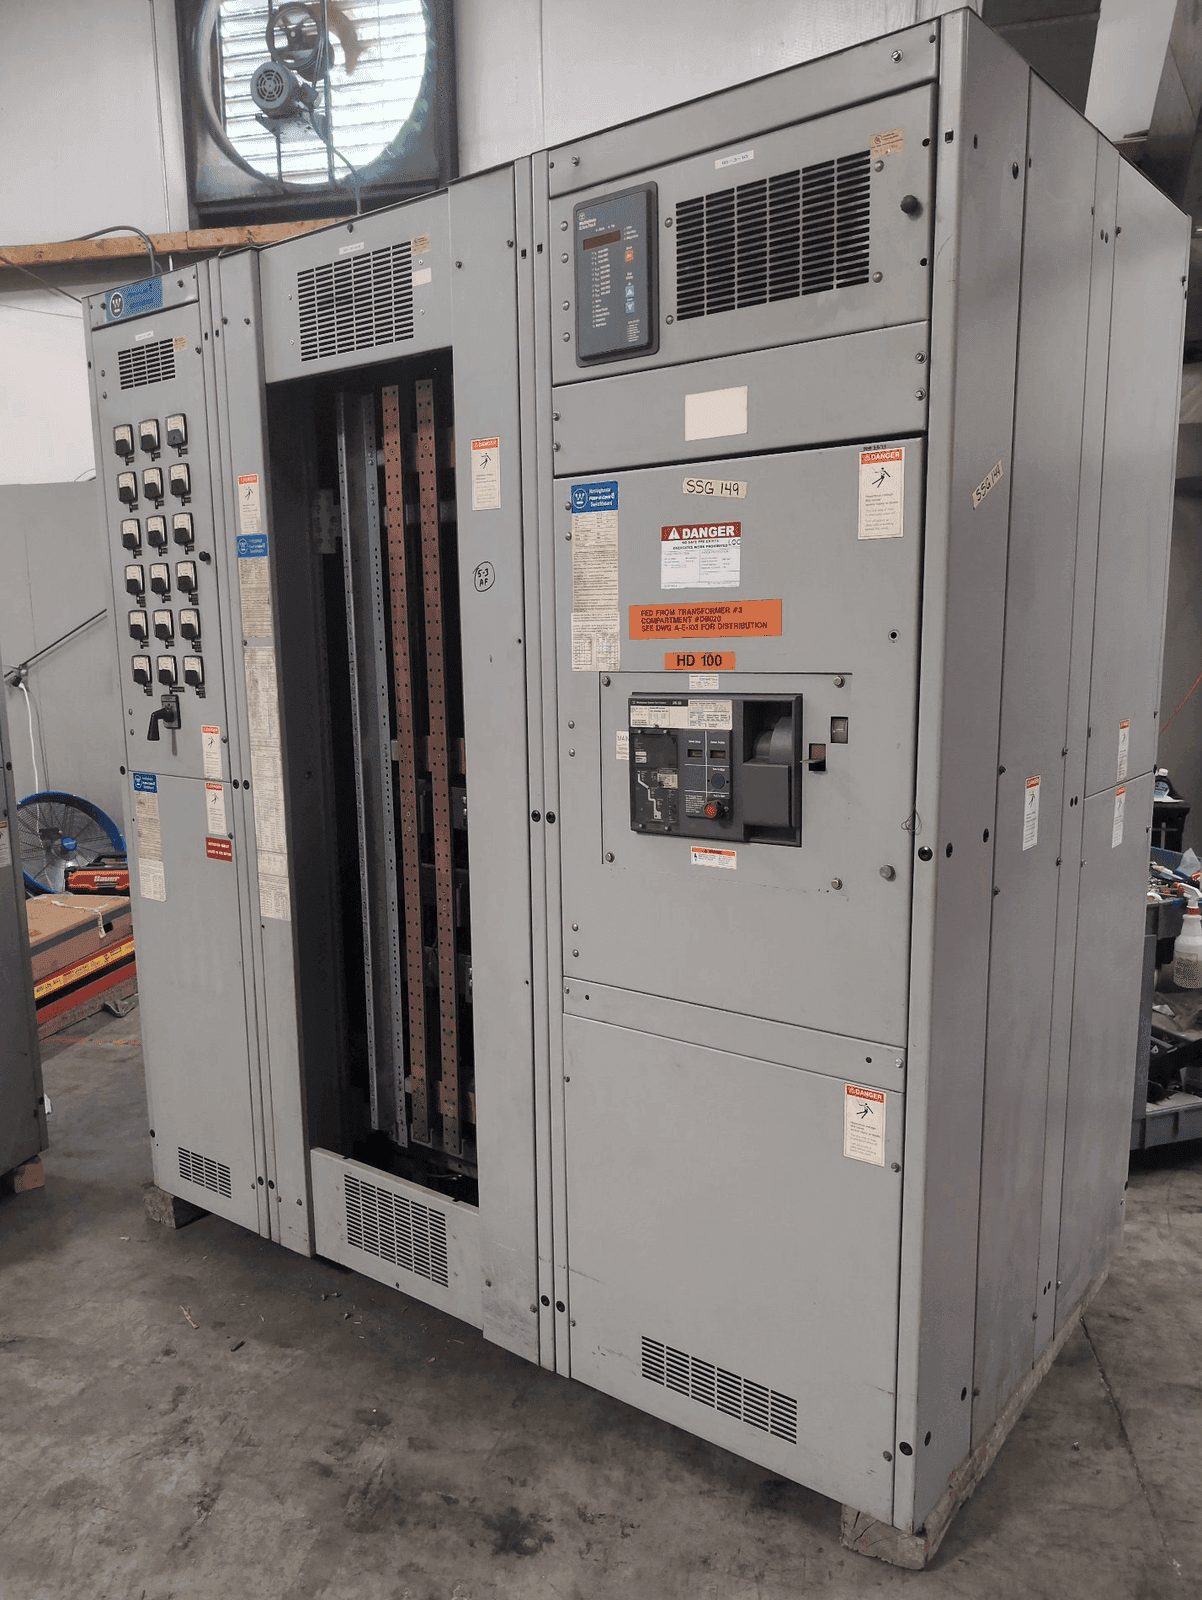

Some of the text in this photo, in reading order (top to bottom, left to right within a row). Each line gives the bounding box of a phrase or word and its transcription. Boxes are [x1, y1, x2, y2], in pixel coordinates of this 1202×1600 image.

[871, 451, 900, 461] DANGER
[686, 479, 740, 496] SSG 149
[975, 477, 991, 501] SSG
[682, 525, 735, 539] DANGER
[640, 606, 743, 617] FED FROM TRANSFORMER #3
[640, 615, 692, 624] COMPARTMENT
[641, 624, 655, 632] SEE
[655, 624, 672, 632] DWG
[700, 622, 716, 630] FOR
[717, 621, 768, 630] DISTRIBUTION
[676, 653, 723, 667] HD 100
[855, 1089, 882, 1100] DANGER
